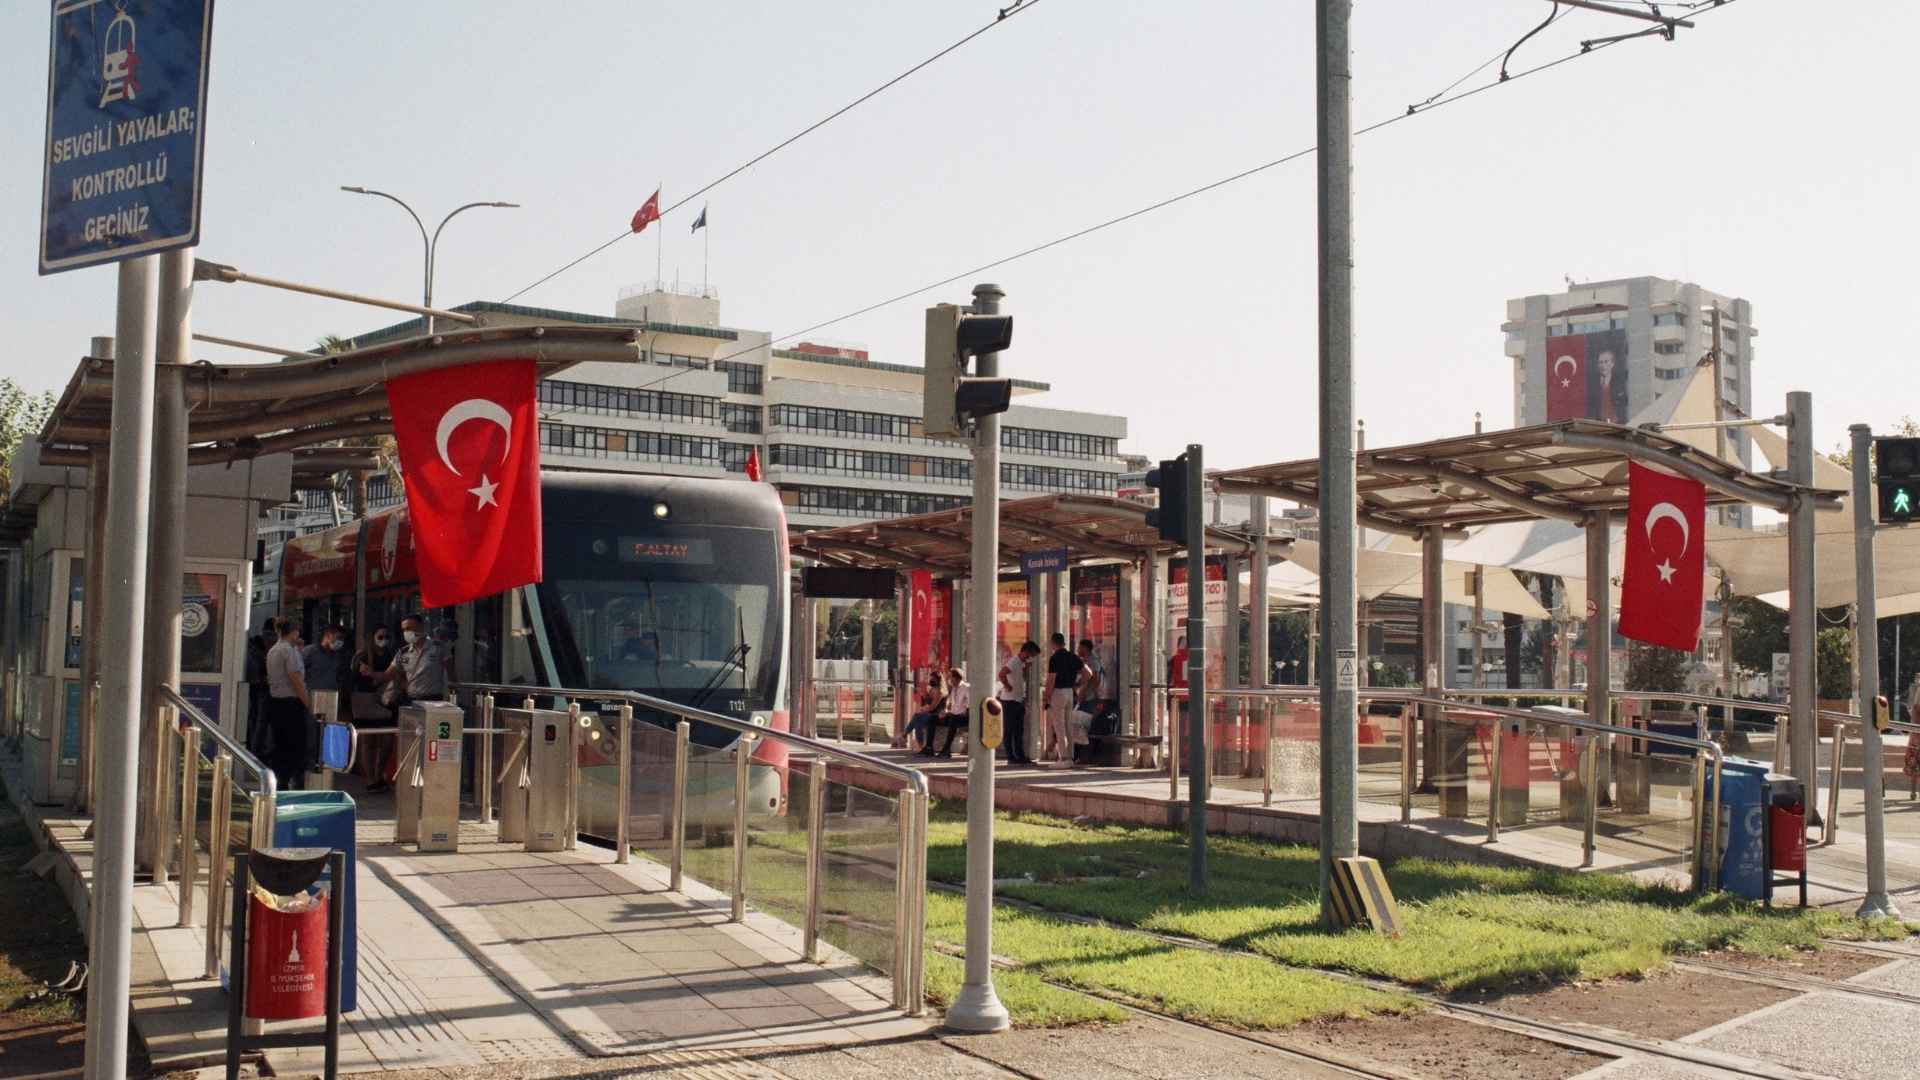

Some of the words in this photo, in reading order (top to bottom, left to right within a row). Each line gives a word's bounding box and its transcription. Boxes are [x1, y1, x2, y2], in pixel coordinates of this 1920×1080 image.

[53, 121, 112, 164] SEVGİLİ
[117, 106, 196, 147] YAYALAR;
[72, 152, 168, 202] KONTROLLÜ
